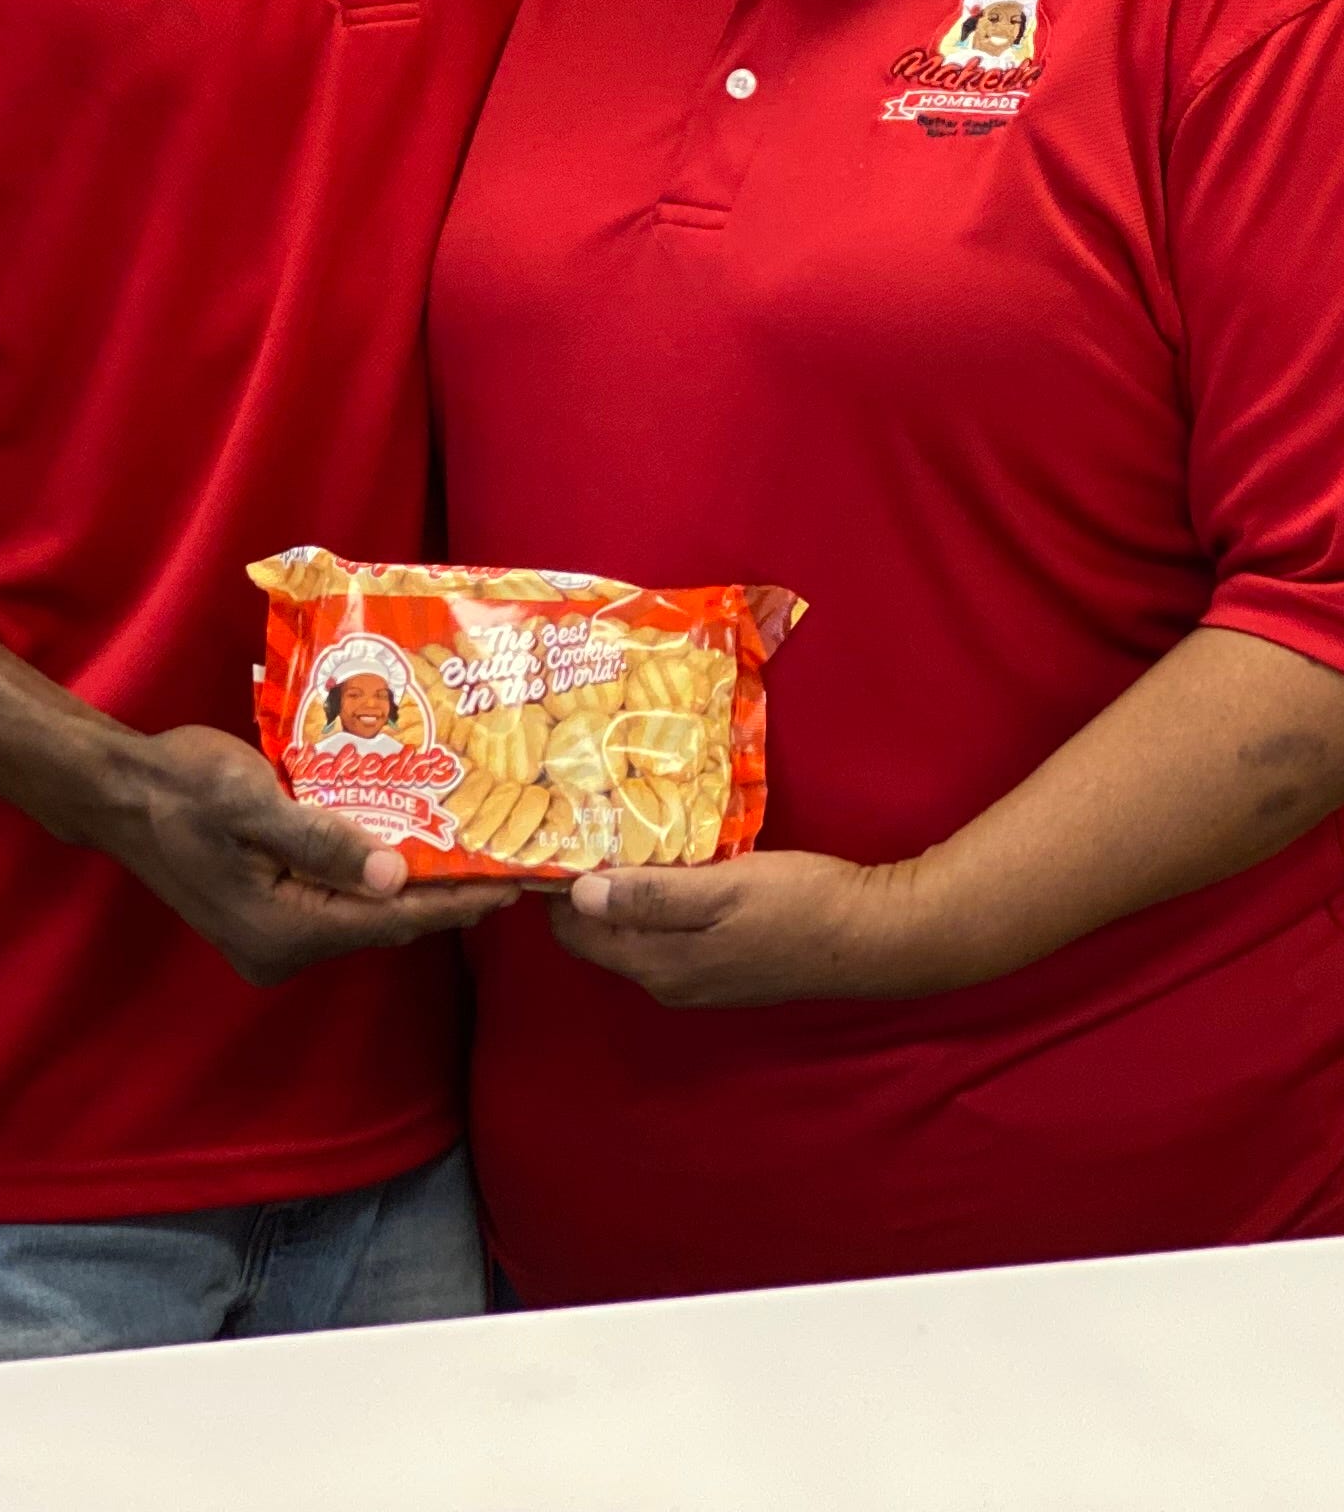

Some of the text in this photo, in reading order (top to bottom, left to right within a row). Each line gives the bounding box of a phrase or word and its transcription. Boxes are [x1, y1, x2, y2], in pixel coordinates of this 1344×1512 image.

[918, 94, 1021, 110] HOMEMADE
[540, 622, 589, 648] Best
[439, 639, 623, 688] Butter Cookies
[455, 684, 495, 717] in
[499, 673, 548, 707] the
[354, 814, 406, 833] Cookies
[572, 807, 625, 825] NET WT
